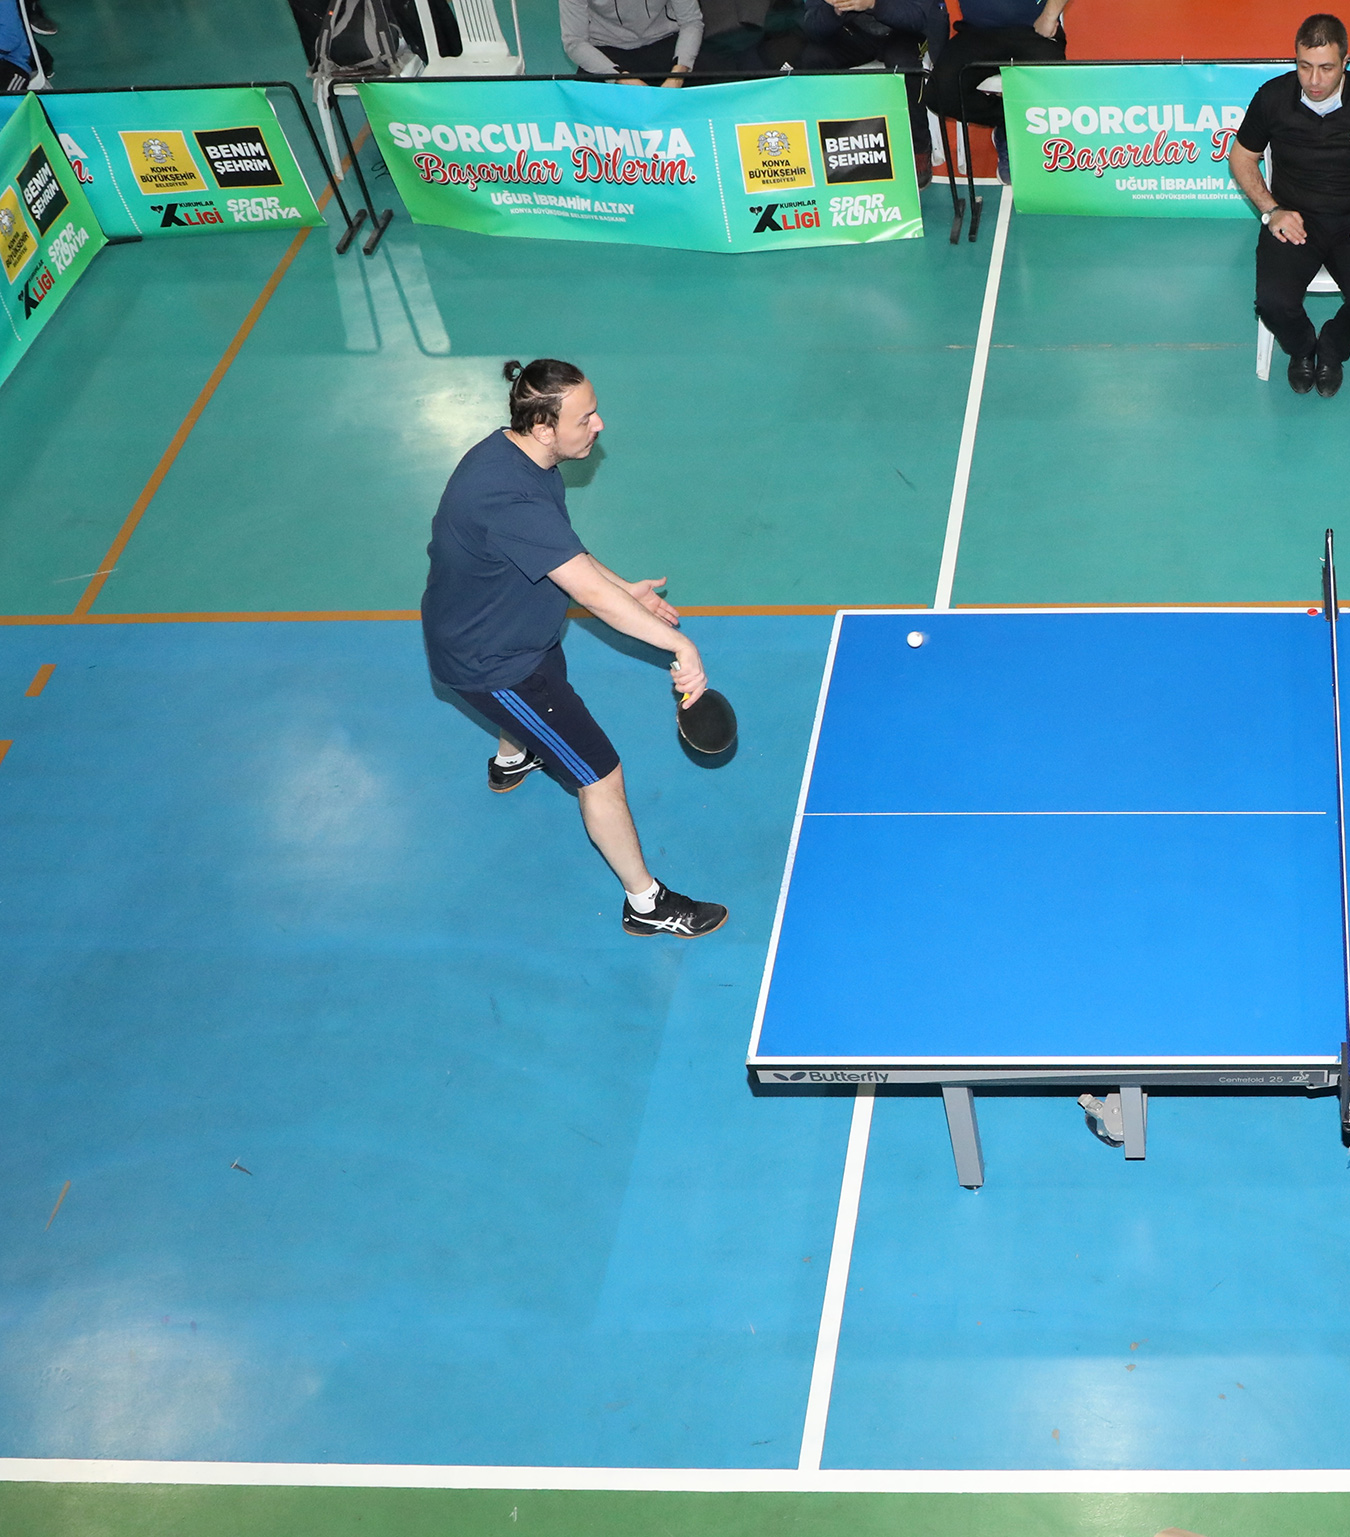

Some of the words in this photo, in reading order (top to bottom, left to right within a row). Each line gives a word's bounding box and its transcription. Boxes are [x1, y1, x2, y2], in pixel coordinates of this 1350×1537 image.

[388, 121, 695, 159] SPORCULARIMIZA
[1042, 129, 1200, 177] Başarılar
[150, 166, 178, 174] KONYA
[413, 148, 563, 191] Başarılar
[571, 145, 698, 185] Dilerim.
[761, 160, 791, 168] KONYA
[748, 168, 807, 179] BÜYÜKŞEHİR
[1115, 176, 1158, 191] UĞUR
[1160, 175, 1224, 191] İBRAHİM
[490, 190, 532, 205] UĞUR
[533, 192, 591, 212] İBRAHİM
[594, 201, 635, 215] ALTAY
[780, 200, 816, 209] KURUMLAR
[809, 1071, 889, 1084] Butterfly
